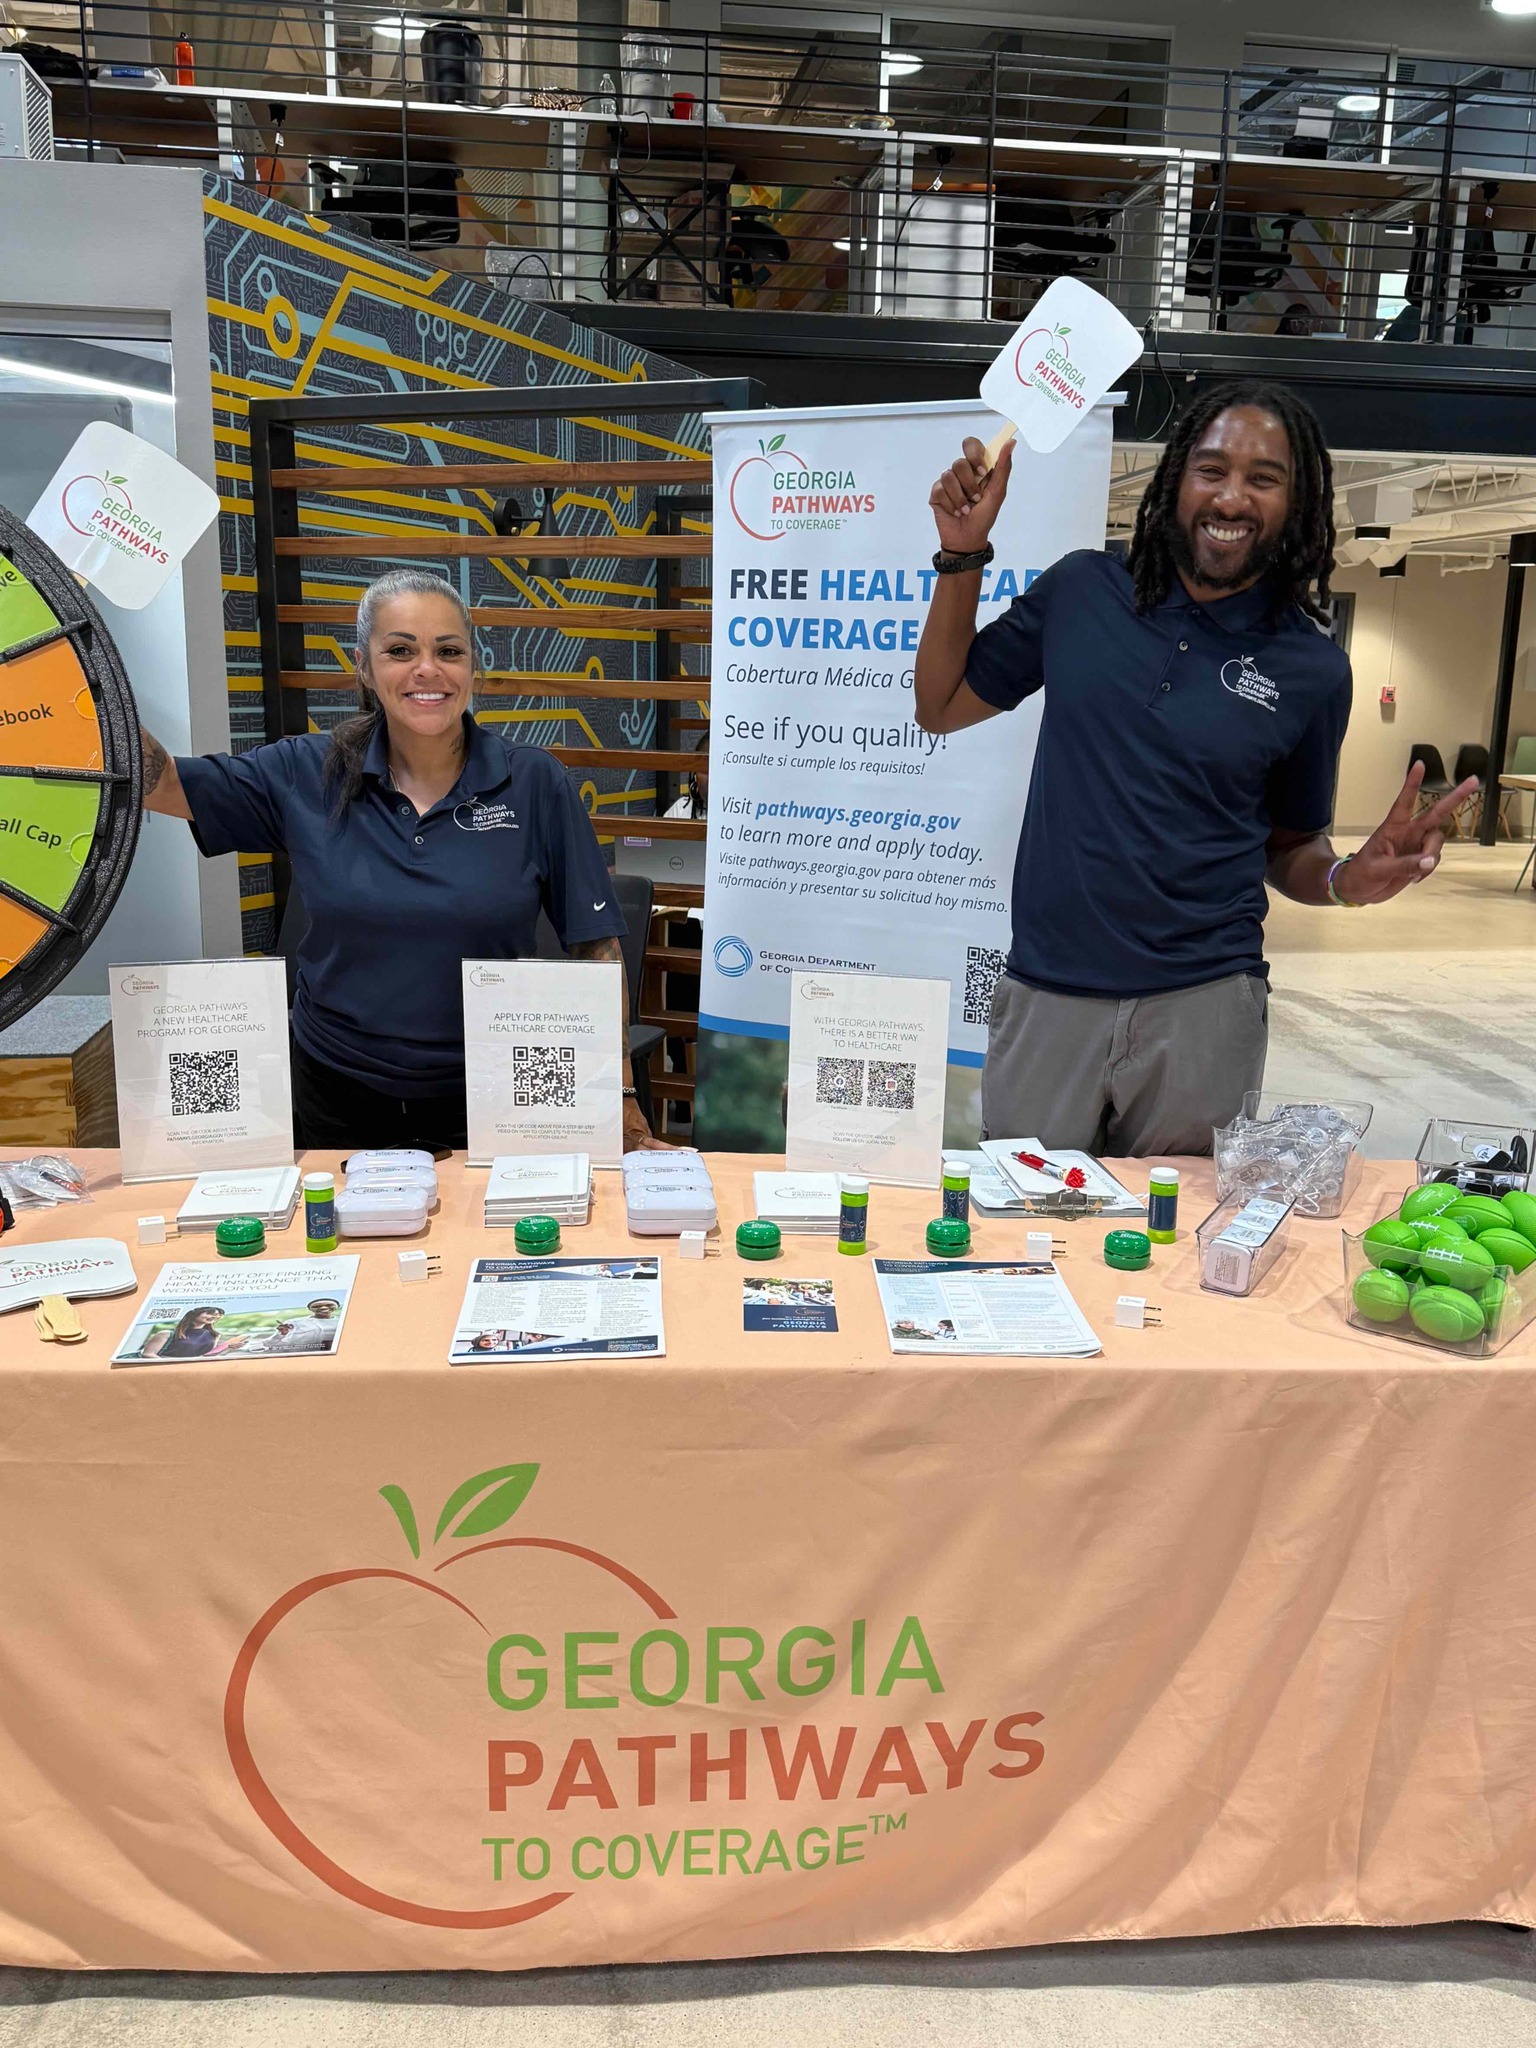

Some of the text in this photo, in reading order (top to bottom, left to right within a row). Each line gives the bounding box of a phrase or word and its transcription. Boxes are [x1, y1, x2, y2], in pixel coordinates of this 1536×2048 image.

[1028, 372, 1036, 382] TO
[1045, 348, 1086, 389] GEORGIA
[1035, 361, 1086, 409] PATHWAYS
[773, 471, 855, 490] GEORGIA
[772, 494, 875, 513] PATHWAYS
[85, 521, 96, 533] TO
[101, 497, 163, 543] GEORGIA
[771, 519, 785, 530] TO
[91, 509, 169, 565] PATHWAYS
[730, 569, 808, 600] FREE
[728, 616, 919, 651] COVERAGE
[726, 663, 818, 686] Cobertura
[825, 666, 893, 689] Médica
[1242, 670, 1276, 689] GEORGIA
[1238, 677, 1280, 700] PATHWAYS
[724, 714, 764, 740] See
[774, 716, 791, 741] if
[796, 724, 843, 749] you
[722, 751, 926, 776] ¡Consulte si cumple los requisitos!
[473, 804, 507, 815] GEORGIA
[473, 811, 515, 822] PATHWAYS
[721, 797, 961, 833] Visit pathways.georgia.gov
[26, 824, 62, 849] Cap
[720, 824, 983, 865] to learn more and apply today.
[719, 852, 996, 890] Visite pathways.georgia.gov para obtener más
[718, 872, 1008, 913] información y presentar su solicitud hoy mismo.
[760, 950, 805, 963] GEORGIA
[808, 956, 876, 971] DEPARTMENT
[153, 1002, 248, 1014] GEORGIA PATHWAYS
[494, 1013, 589, 1022] APPLY FOR PATHWAYS
[153, 1013, 248, 1026] A NEW HEALTHCARE
[489, 1024, 595, 1034] HEALTHCARE COVERAGE
[814, 1017, 836, 1025] WITH
[837, 1018, 877, 1028] GEORGIA
[137, 1024, 266, 1038] PROGRAM FOR GEORGIANS
[820, 1027, 847, 1037] THERE
[849, 1030, 856, 1038] IS
[866, 1031, 898, 1041] BETTER
[900, 1033, 919, 1042] WAY
[848, 1041, 903, 1052] HEALTHCARE
[10, 1258, 92, 1273] GEORGIA
[12, 1260, 114, 1279] PATHWAYS
[222, 1277, 301, 1285] INSURANCE
[487, 1615, 946, 1713] GEORGIA
[488, 1709, 1047, 1813] PATHWAYS
[481, 1836, 552, 1882] TO
